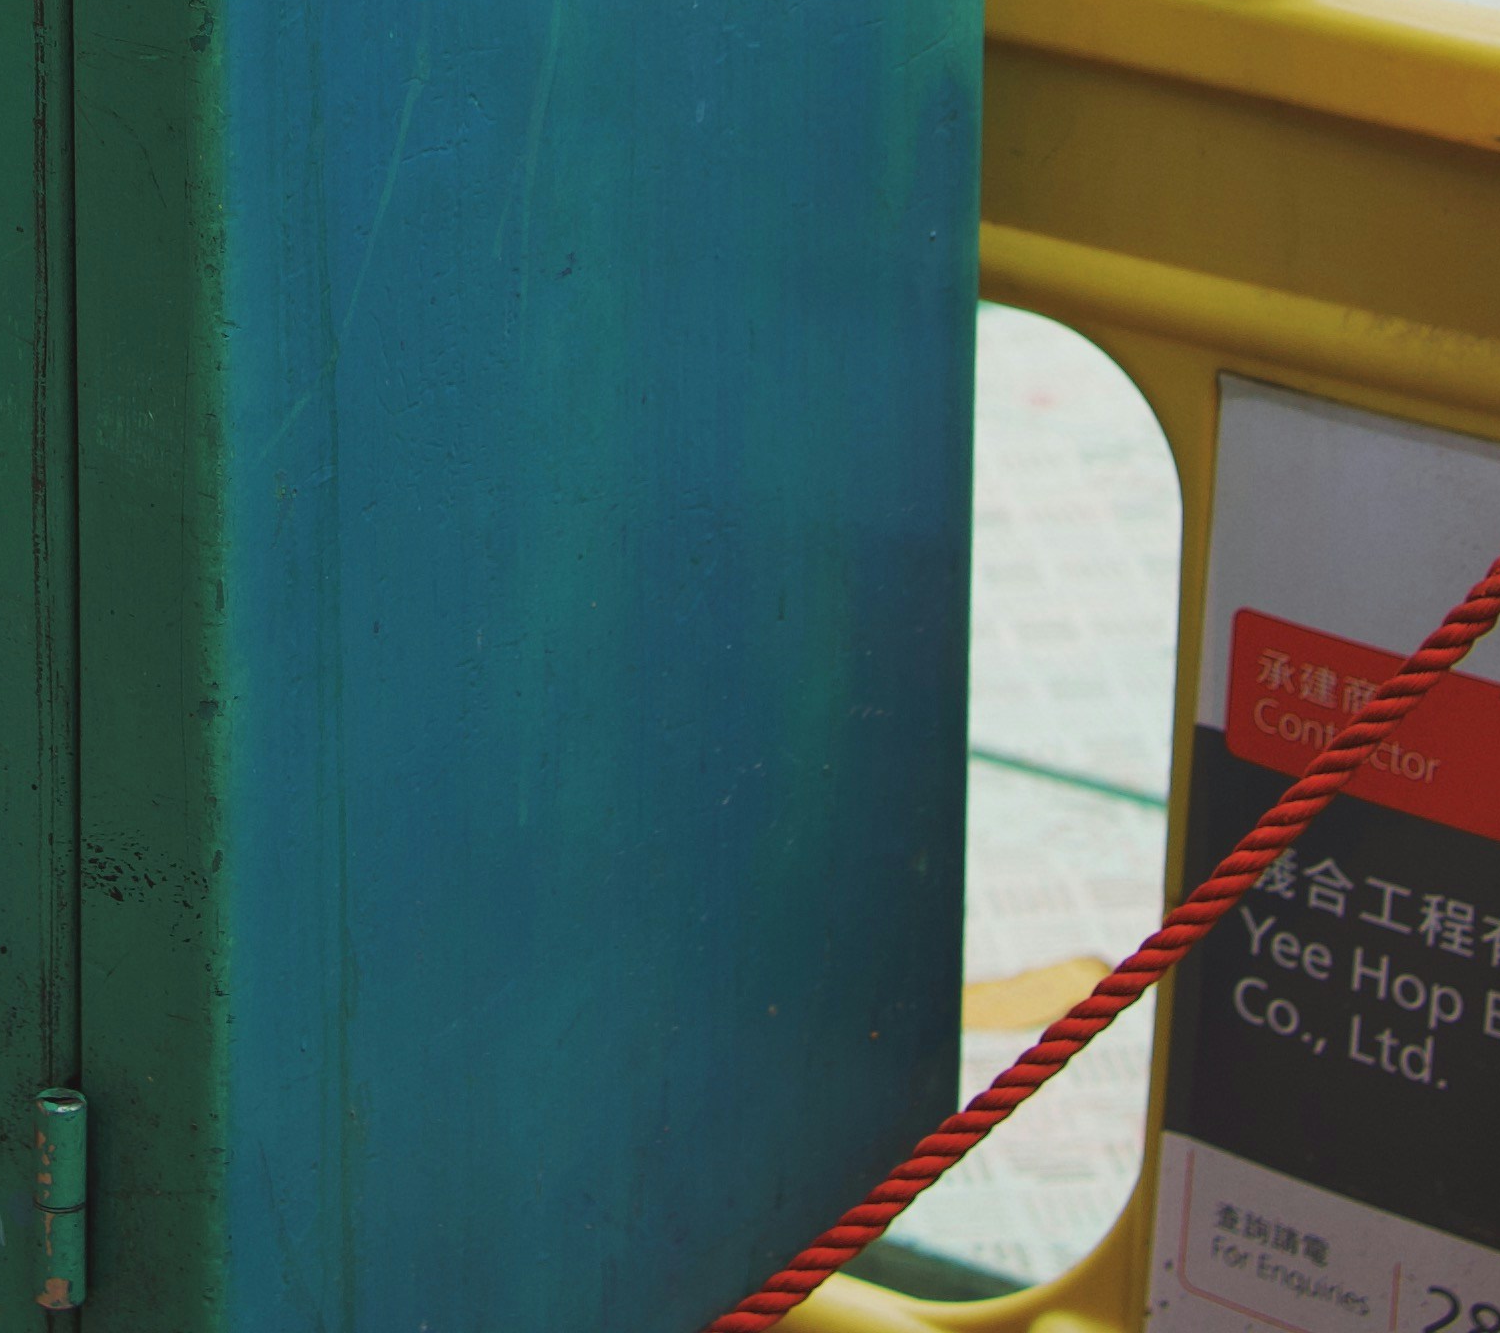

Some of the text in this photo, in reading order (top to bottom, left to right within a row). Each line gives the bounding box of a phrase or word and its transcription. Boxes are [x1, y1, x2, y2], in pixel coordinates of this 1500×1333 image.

[1254, 696, 1442, 783] Contctor
[1239, 905, 1334, 980] Yee
[1352, 947, 1464, 1029] Hop
[1233, 976, 1449, 1090] Co., Ltd.
[1211, 1235, 1370, 1317] For Enquiries
